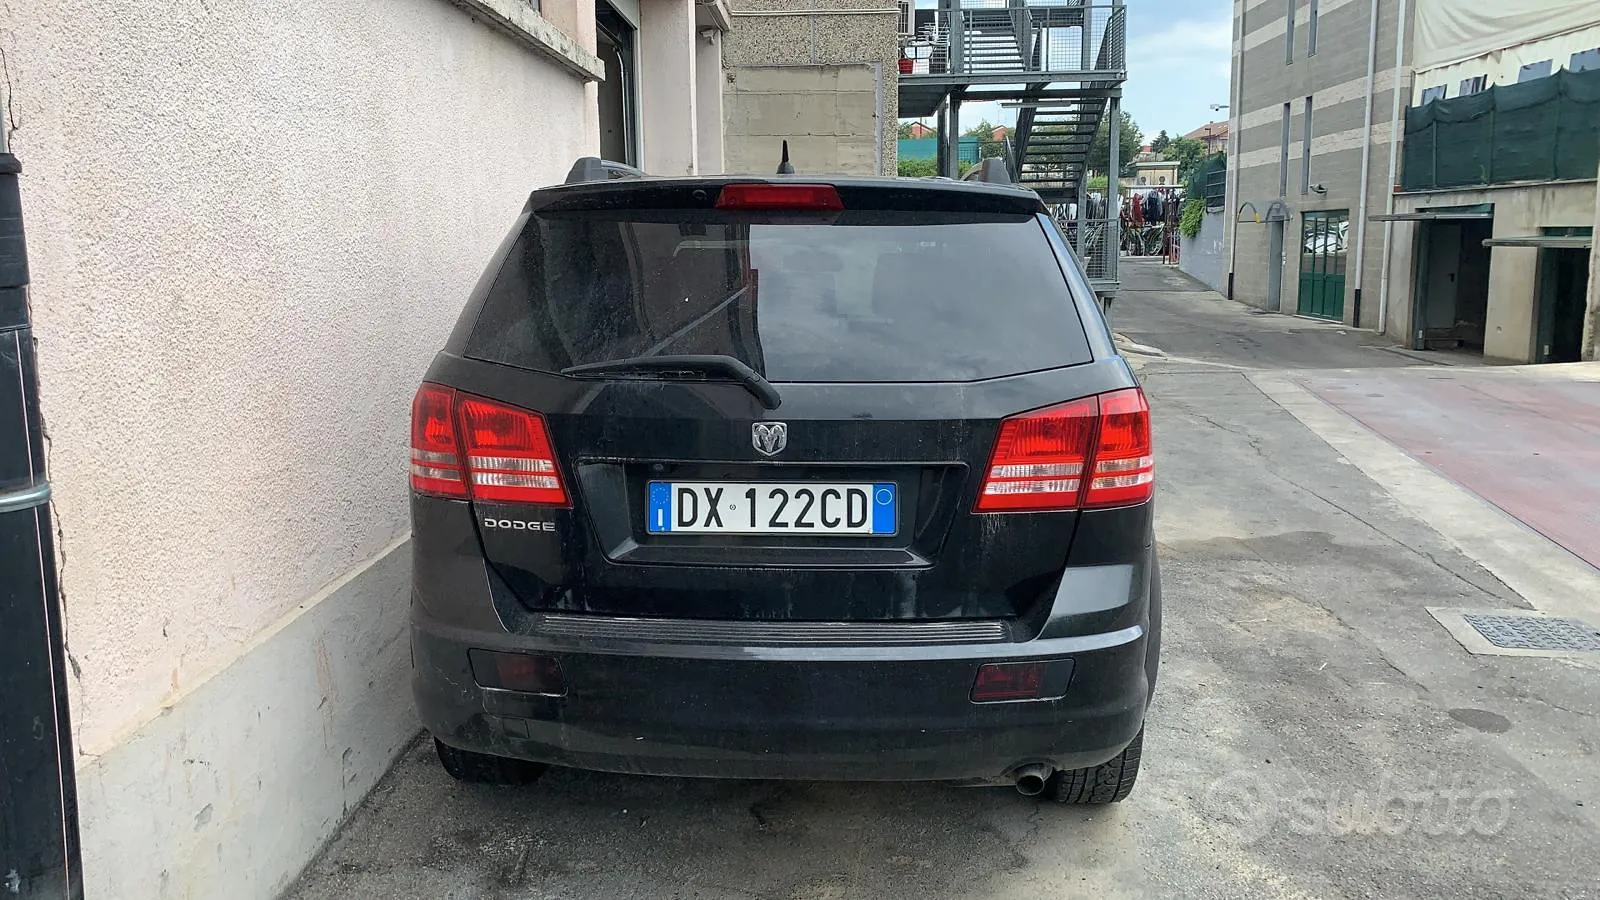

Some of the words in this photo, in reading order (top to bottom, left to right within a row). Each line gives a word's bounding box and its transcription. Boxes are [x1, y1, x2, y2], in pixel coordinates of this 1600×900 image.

[677, 487, 724, 528] DX
[744, 487, 868, 528] 122CD
[484, 517, 556, 532] DODGE
